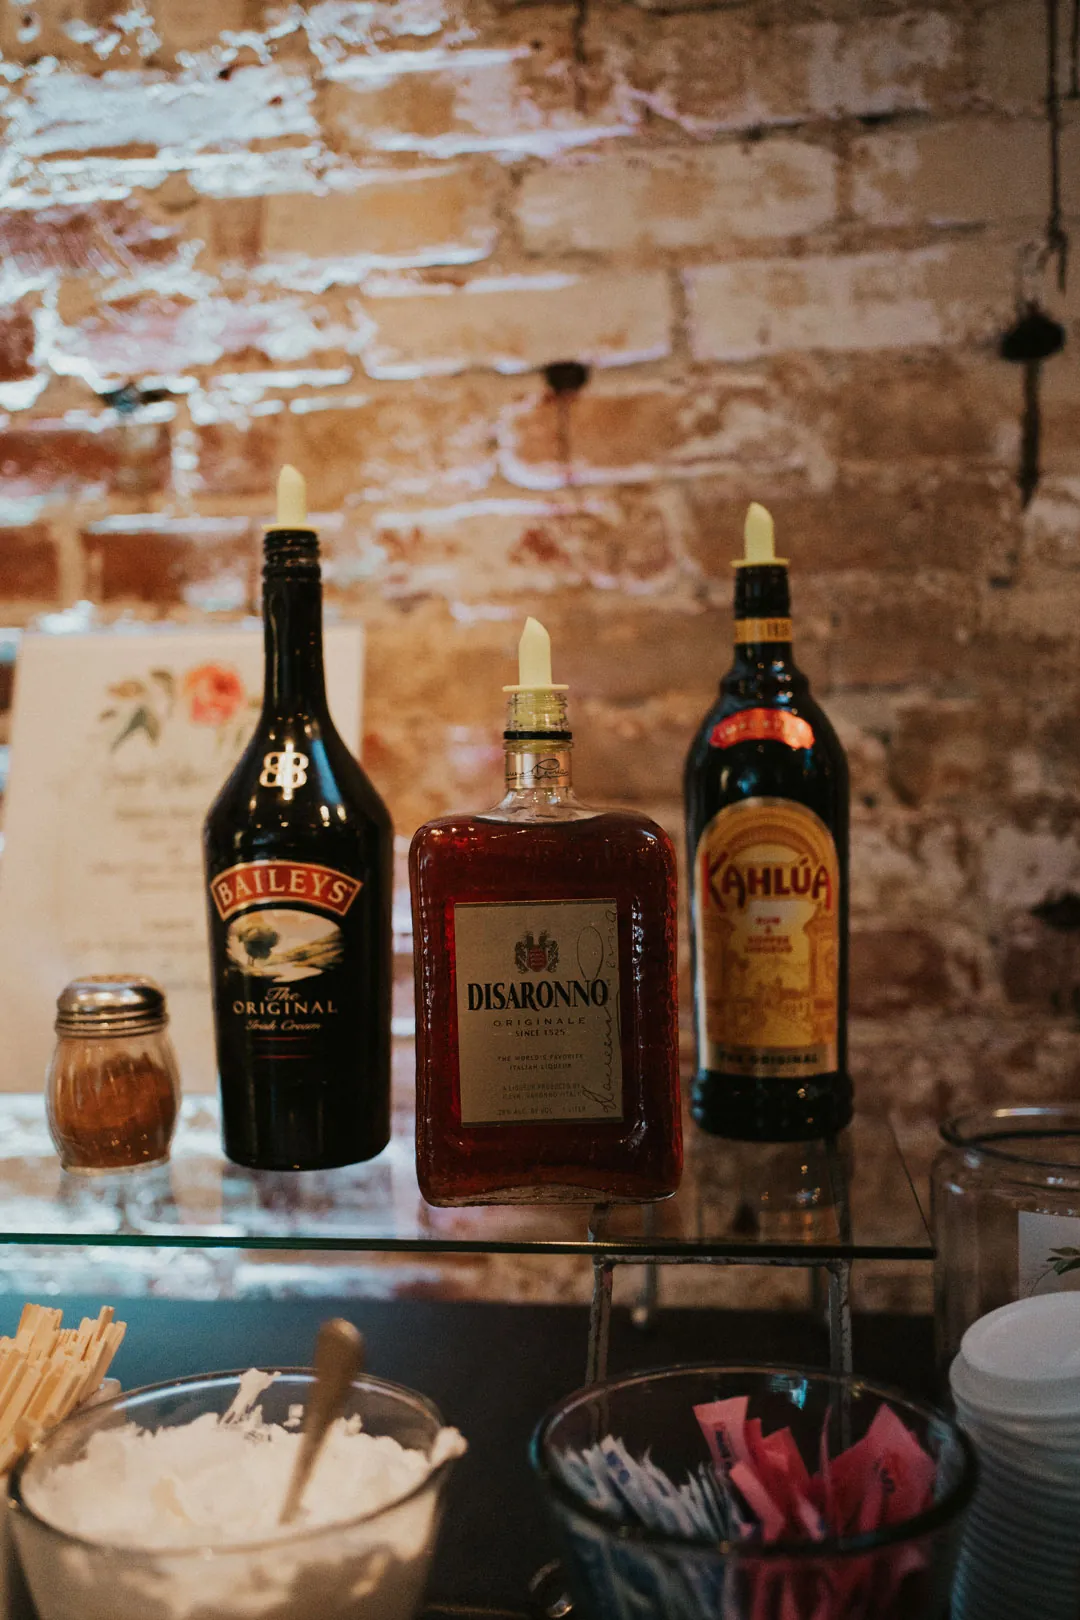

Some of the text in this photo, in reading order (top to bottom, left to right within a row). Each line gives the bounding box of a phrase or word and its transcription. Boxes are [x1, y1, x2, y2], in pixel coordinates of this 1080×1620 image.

[217, 867, 350, 906] BAILEYS
[702, 851, 832, 912] KAHLÚA
[265, 986, 300, 1001] The
[467, 978, 609, 1012] DISARONNO
[232, 1000, 338, 1015] ORIGINAL
[493, 1016, 586, 1027] ORIGINALE
[515, 1028, 566, 1037] SINCE 1525
